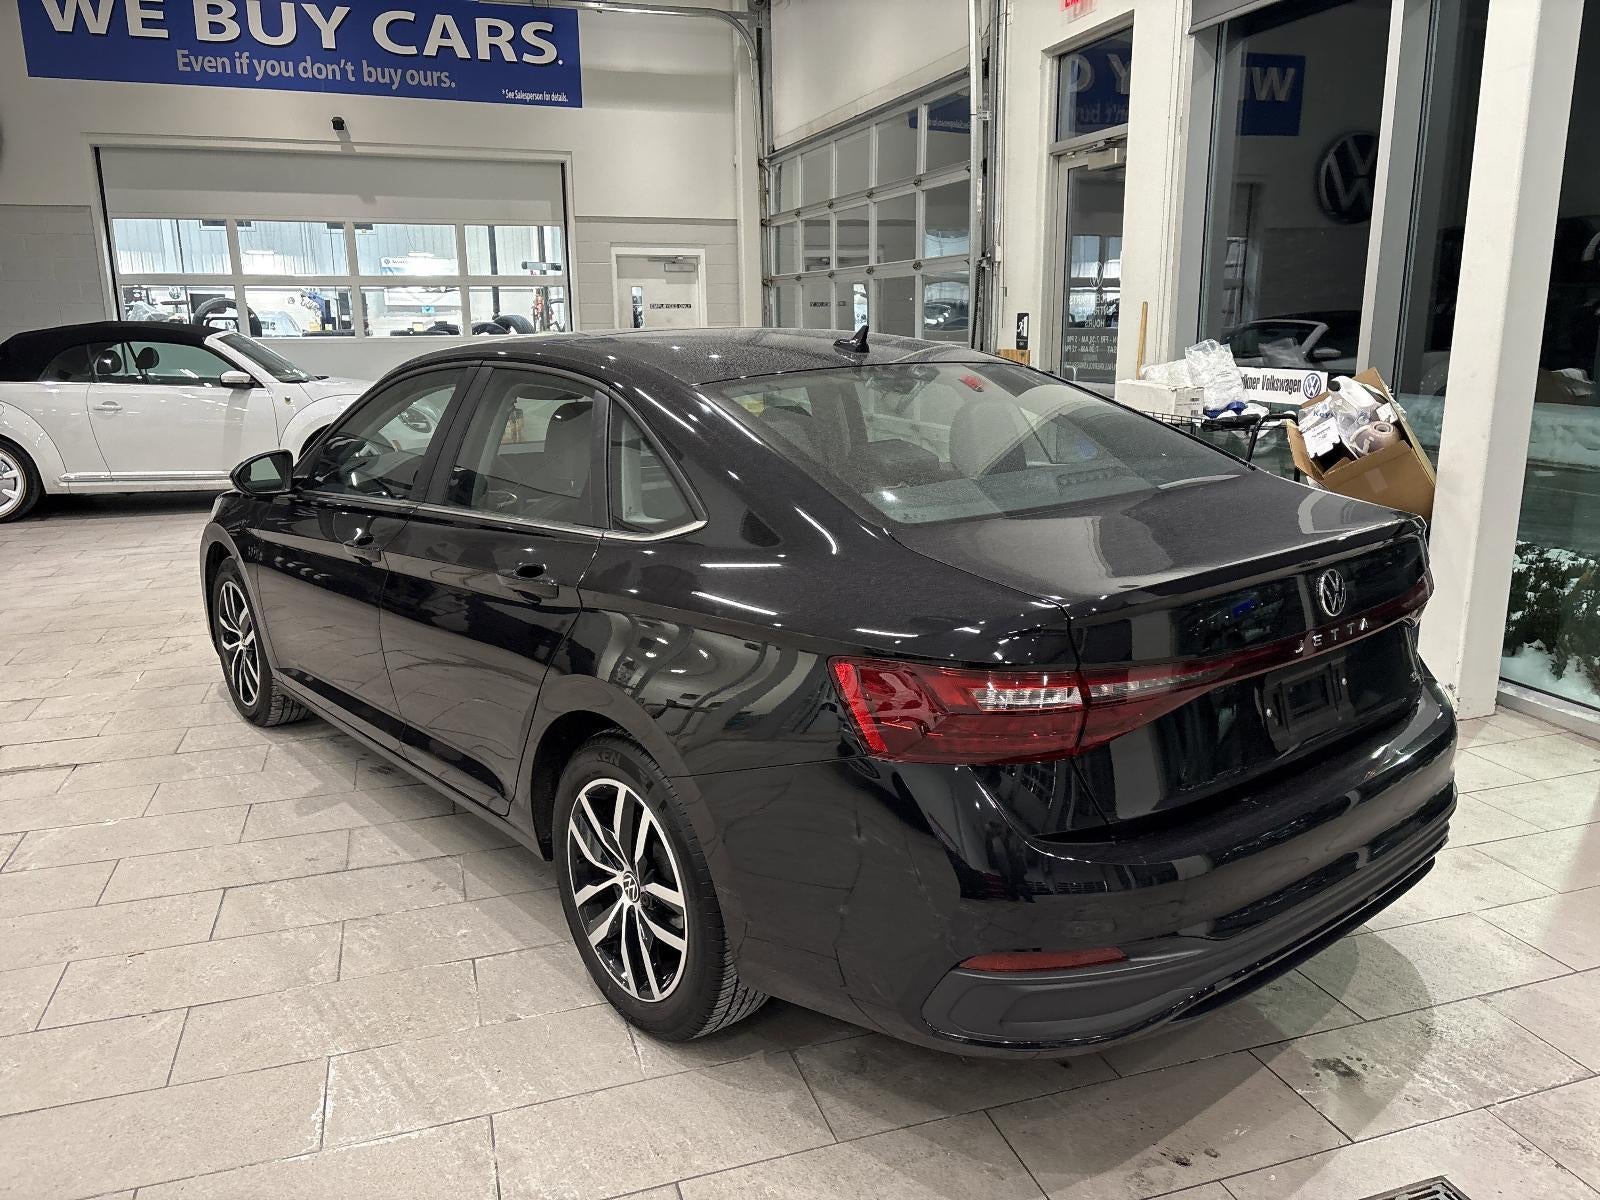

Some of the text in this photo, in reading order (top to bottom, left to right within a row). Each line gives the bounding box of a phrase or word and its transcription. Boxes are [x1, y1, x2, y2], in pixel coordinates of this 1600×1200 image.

[41, 0, 564, 65] WE BUY CARS.
[176, 49, 456, 90] Even if you don't buy ours.
[515, 89, 543, 103] Salesperson
[543, 91, 551, 102] for
[551, 91, 568, 103] details.
[1261, 375, 1302, 395] Volkswagen
[1295, 618, 1369, 654] JETTA
